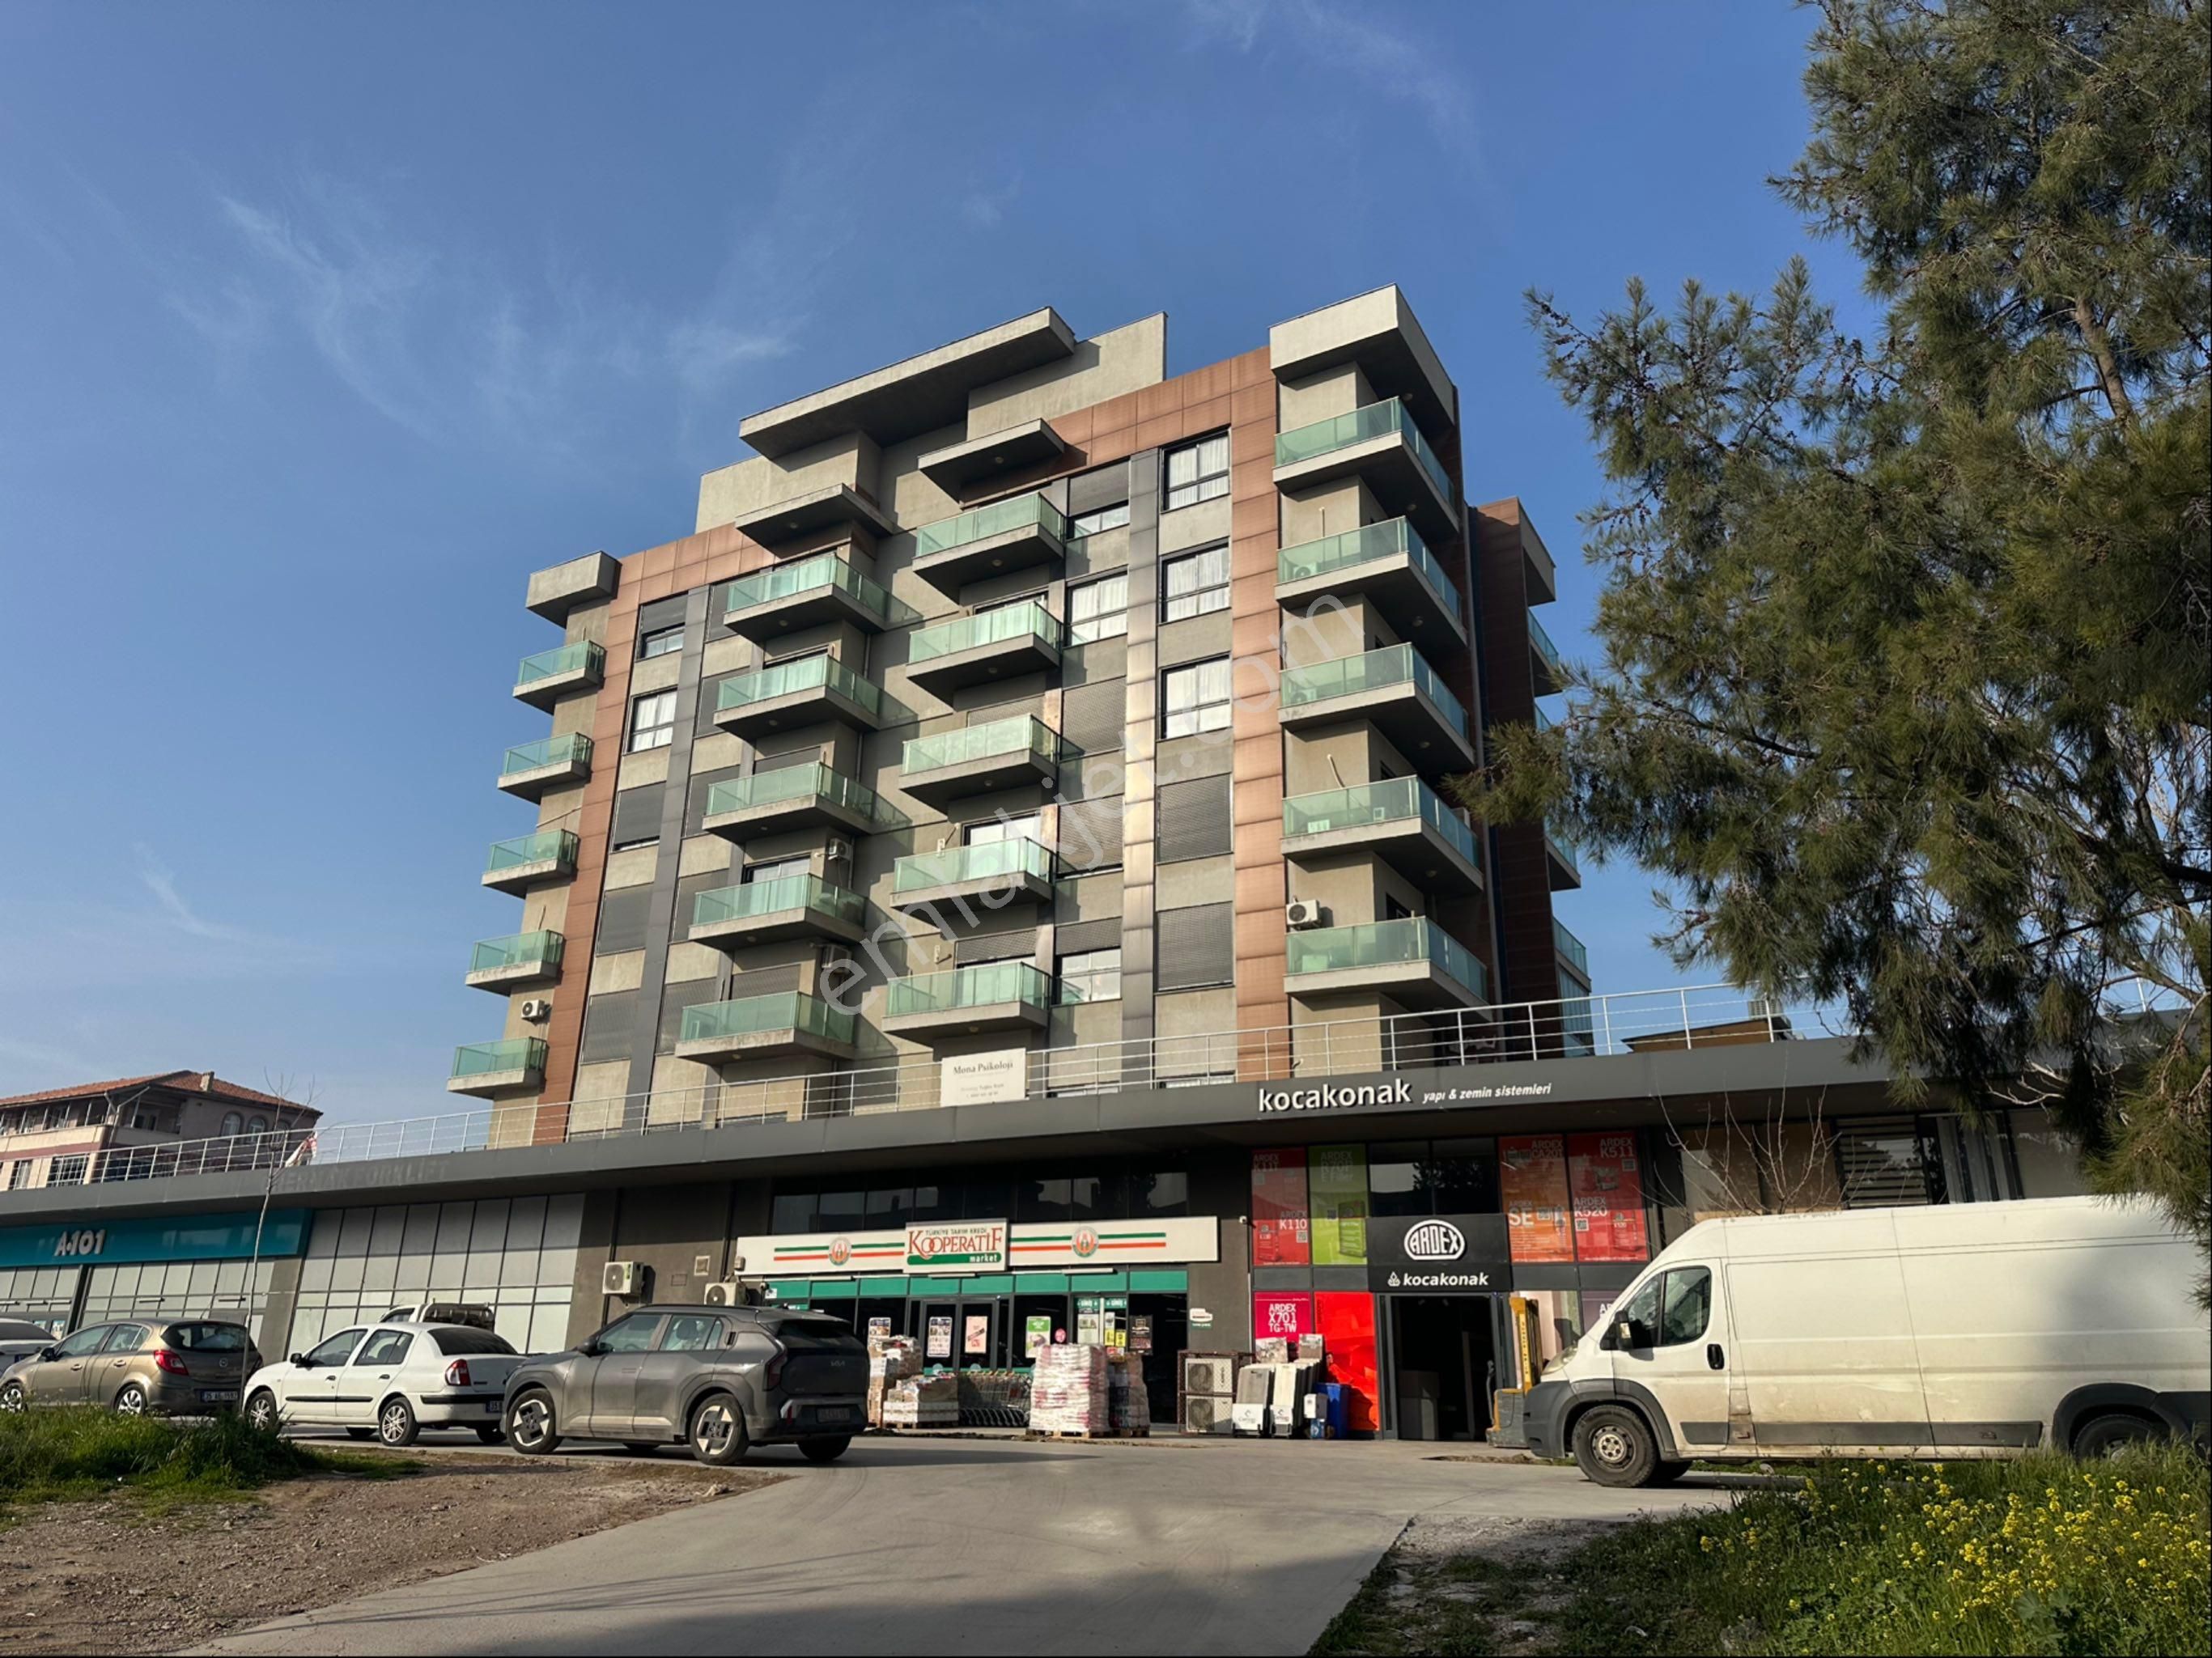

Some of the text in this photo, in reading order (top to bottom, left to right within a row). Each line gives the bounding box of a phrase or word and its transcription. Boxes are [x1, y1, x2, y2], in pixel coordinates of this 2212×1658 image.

[953, 1066, 976, 1075] Mona
[978, 1060, 1013, 1072] Psikoloji
[1259, 1079, 1412, 1112] kocakonak
[1423, 1083, 1552, 1104] yapı & zemin sistemleri
[1531, 1139, 1563, 1149] ARDEX
[1600, 1137, 1632, 1147] ARDEX
[1321, 1151, 1353, 1161] ARDEX
[1601, 1146, 1633, 1158] K511
[1254, 1154, 1278, 1163] ARDEX
[1574, 1197, 1606, 1206] ARDEX
[1280, 1211, 1307, 1219] ARDEX
[1574, 1204, 1607, 1217] K520
[1508, 1208, 1535, 1227] SE
[1280, 1219, 1307, 1230] K110
[1409, 1224, 1459, 1255] ARDEX
[969, 1253, 997, 1263] market
[1403, 1272, 1489, 1287] kocakonak
[1269, 1304, 1297, 1312] ARDEX
[1269, 1312, 1297, 1324] X701
[1269, 1323, 1297, 1333] TG-TW
